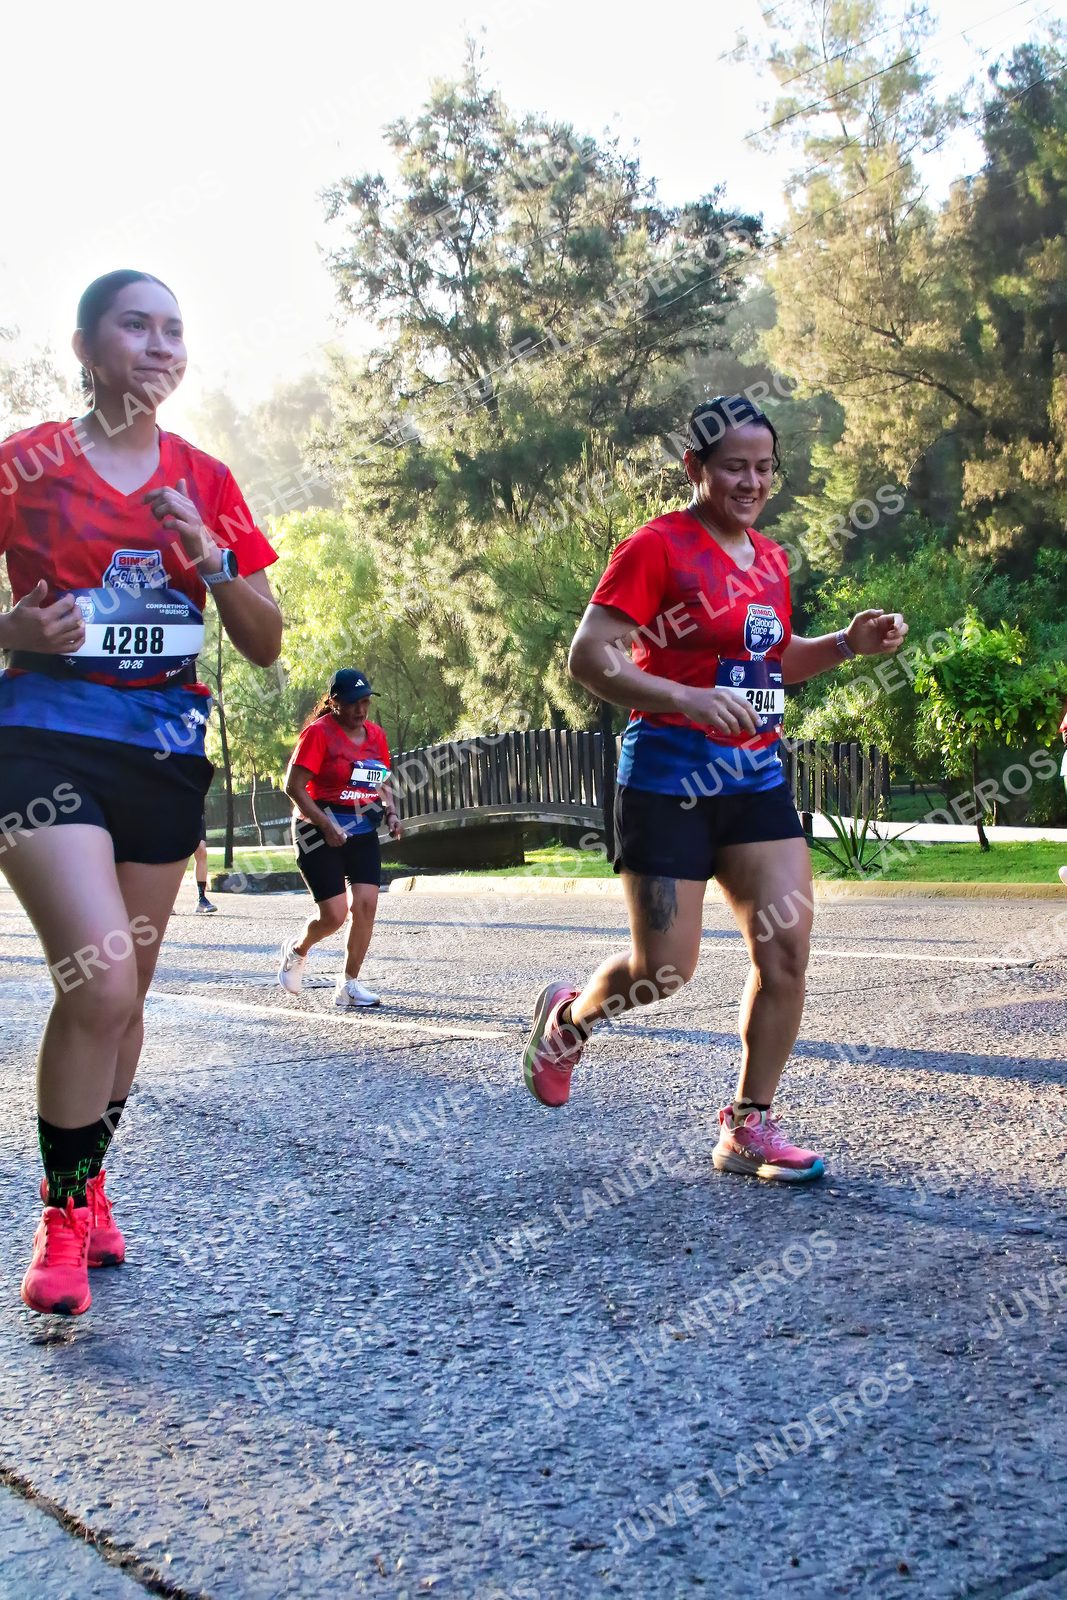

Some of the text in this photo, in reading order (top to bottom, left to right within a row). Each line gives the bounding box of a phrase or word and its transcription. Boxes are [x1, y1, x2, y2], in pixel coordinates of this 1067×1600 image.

[751, 608, 773, 617] BIMBO
[754, 617, 775, 628] Global
[751, 625, 768, 635] Race
[102, 626, 164, 655] 4288
[745, 690, 775, 713] 3944
[366, 770, 381, 782] 4112
